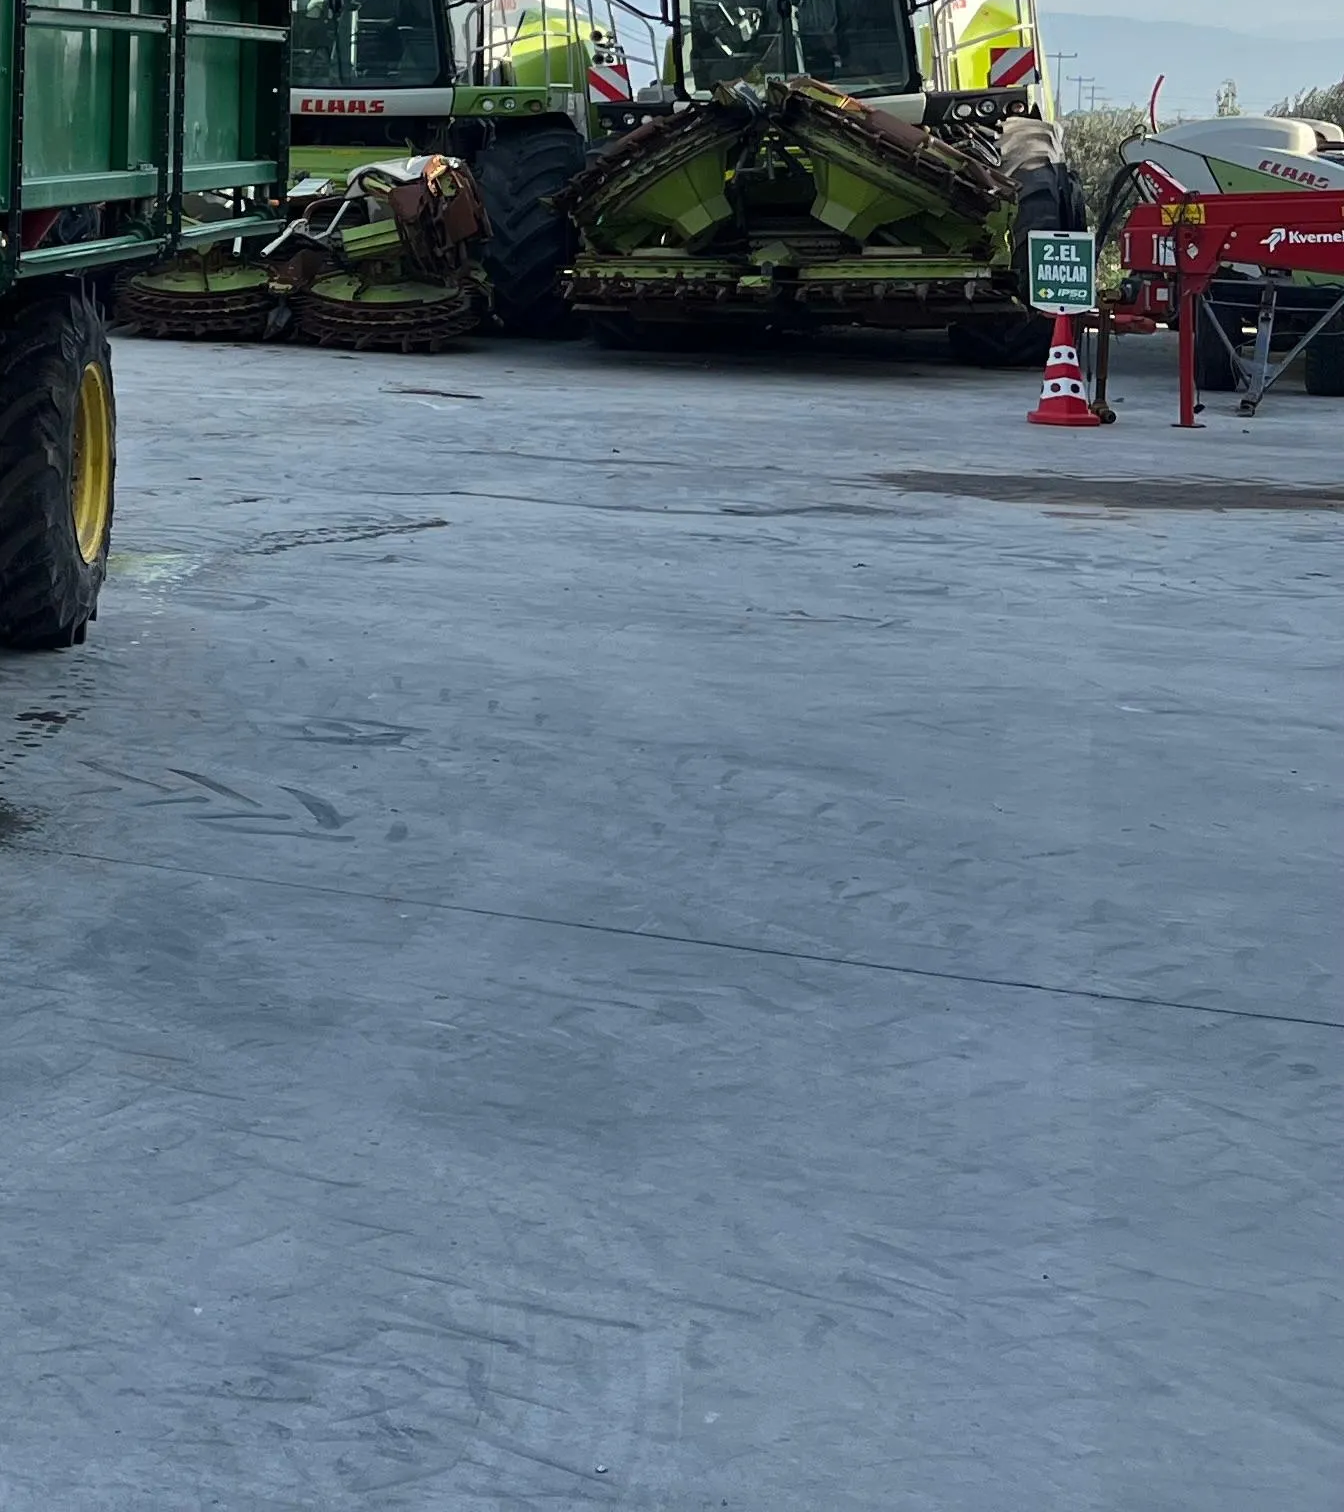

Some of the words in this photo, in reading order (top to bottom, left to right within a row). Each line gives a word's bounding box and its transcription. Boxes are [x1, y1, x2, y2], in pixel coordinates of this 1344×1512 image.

[301, 99, 385, 114] CLAAS
[1258, 159, 1331, 189] CLAAS
[1043, 244, 1081, 262] 2.EL
[1037, 263, 1087, 284] ARAÇLAR
[1057, 288, 1088, 298] IPSO
